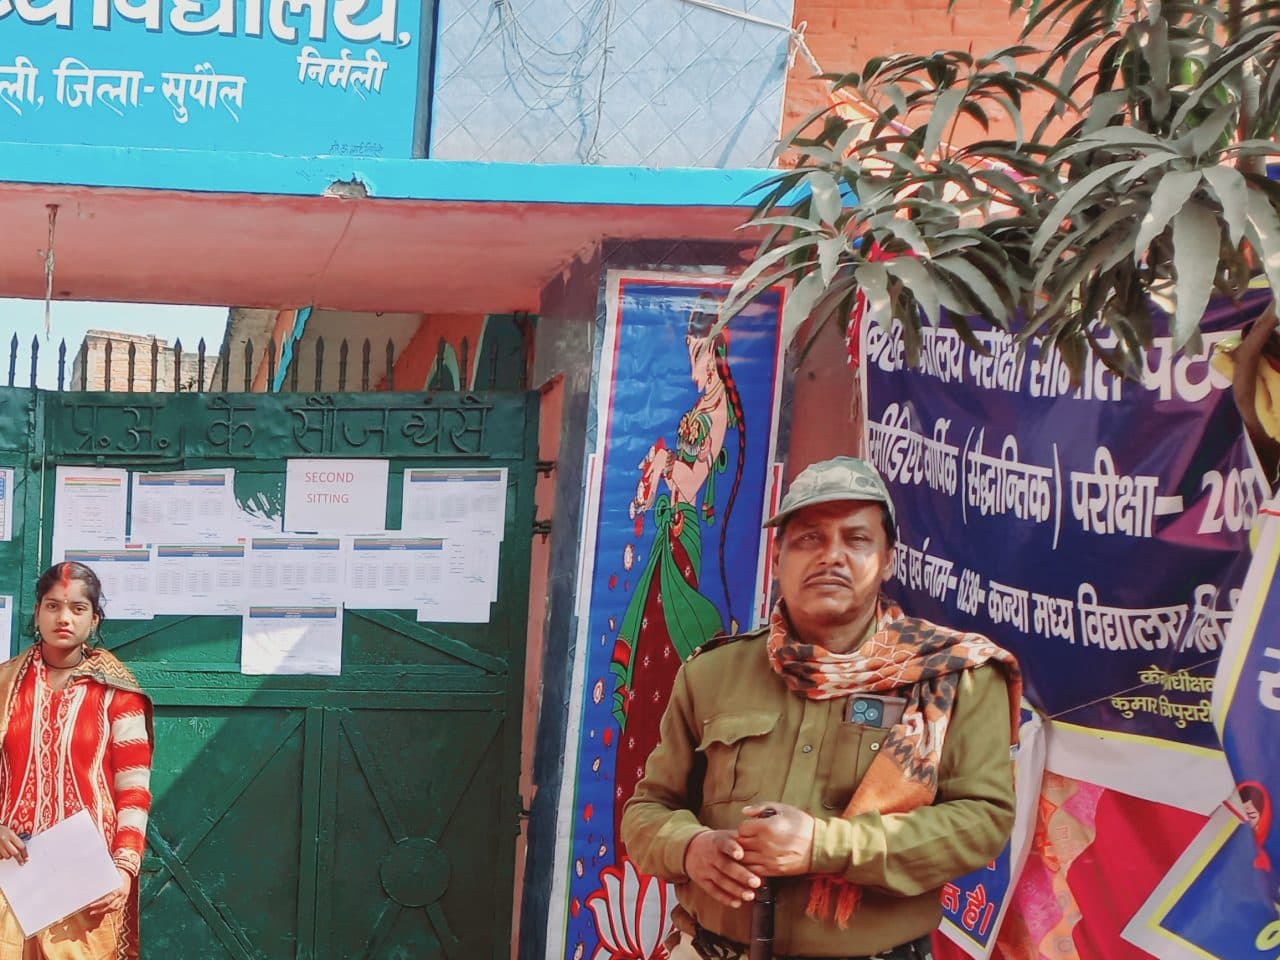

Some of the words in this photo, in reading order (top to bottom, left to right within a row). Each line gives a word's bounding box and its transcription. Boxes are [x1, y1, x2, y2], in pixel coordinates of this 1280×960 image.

[161, 62, 248, 123] सुपौल
[297, 47, 388, 103] निर्मली
[304, 471, 355, 483] SECOND
[306, 493, 350, 504] SITTING
[988, 580, 1029, 633] कन्या
[1032, 592, 1075, 644] मध्य
[1077, 583, 1189, 652] विद्यालय
